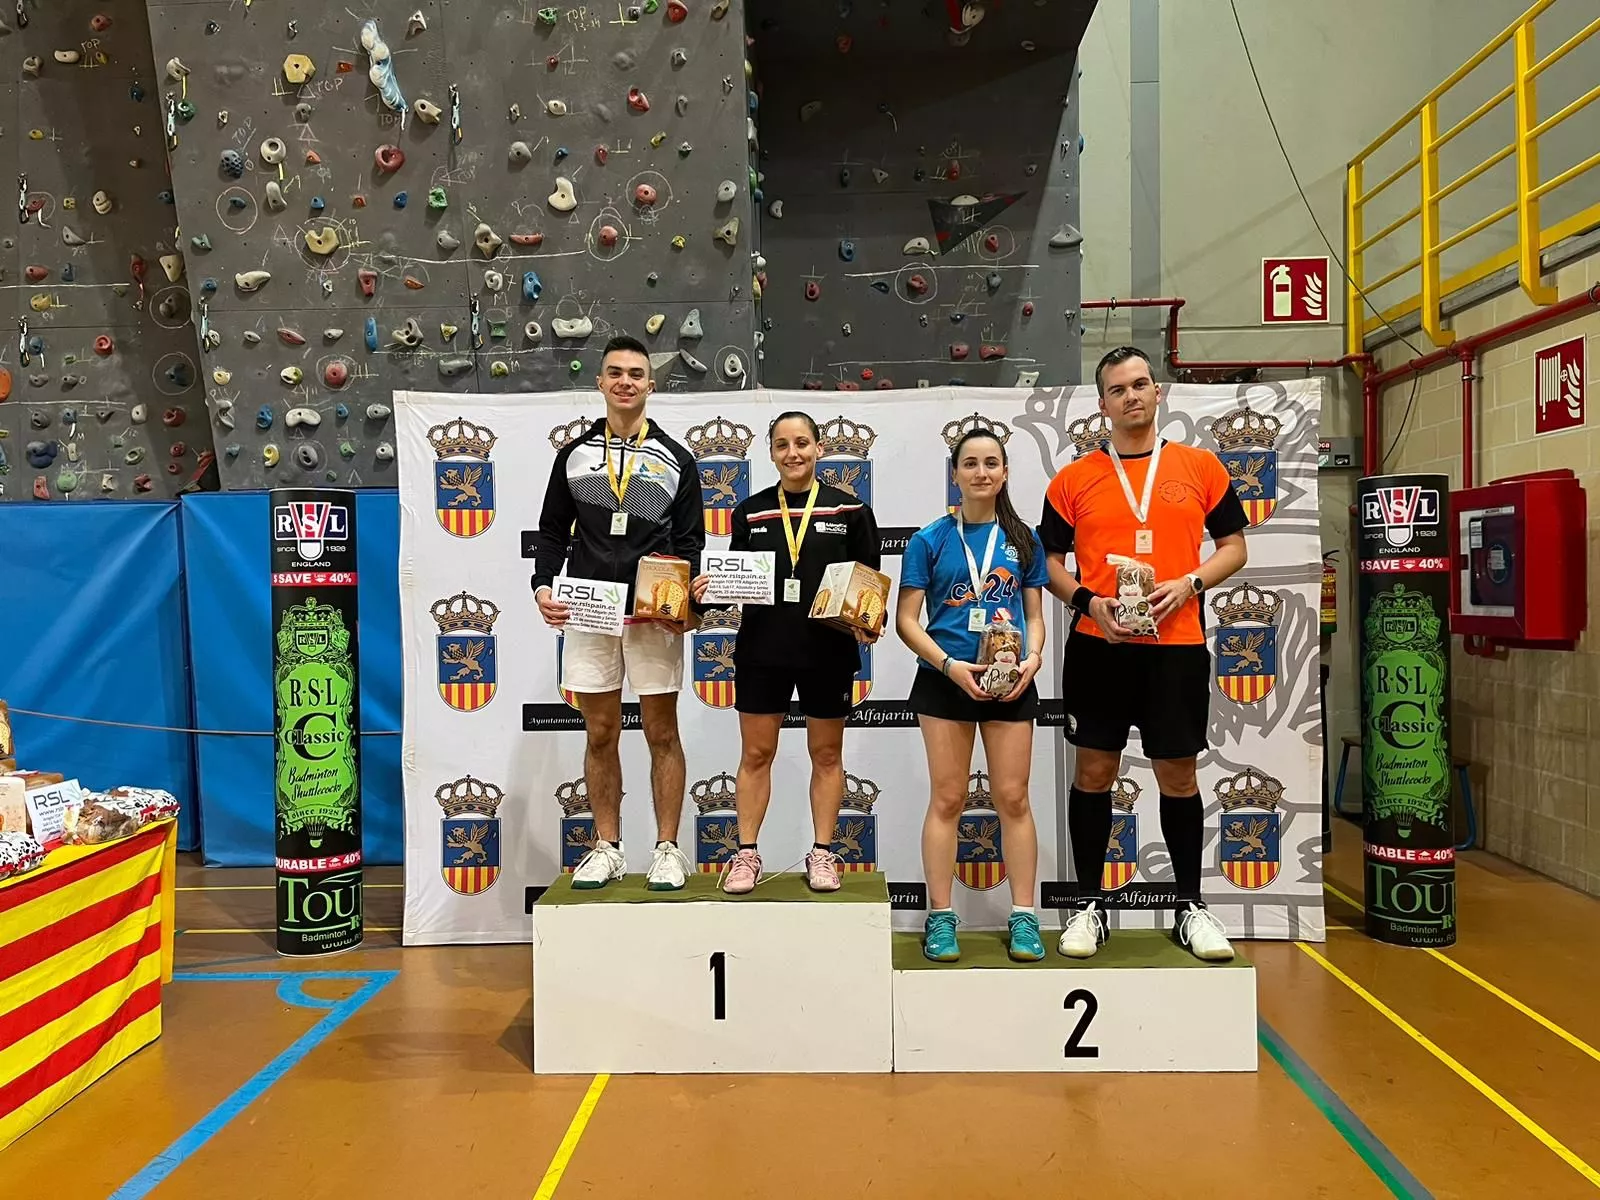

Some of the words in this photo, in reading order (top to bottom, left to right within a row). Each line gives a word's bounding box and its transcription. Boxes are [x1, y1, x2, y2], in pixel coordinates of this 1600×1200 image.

[564, 6, 587, 23] TOP
[1365, 498, 1436, 520] RSL
[277, 514, 345, 533] RSL
[707, 558, 752, 572] RSL
[1418, 558, 1444, 570] 40%
[329, 572, 352, 583] 40%
[557, 584, 603, 602] RSL
[528, 717, 584, 725] Ayuntamiento
[852, 709, 914, 724] Alfajarín
[1372, 716, 1434, 732] Classic
[285, 728, 344, 745] Classic
[1376, 752, 1428, 772] Badminton
[288, 766, 338, 786] Badminton
[1379, 770, 1432, 788] Shuttlecocks
[292, 778, 342, 801] Shuttlecocks
[33, 790, 70, 810] RSL
[302, 930, 347, 942] Badminton
[1390, 922, 1438, 934] Badminton
[709, 951, 725, 1018] 1
[1063, 988, 1098, 1058] 2
